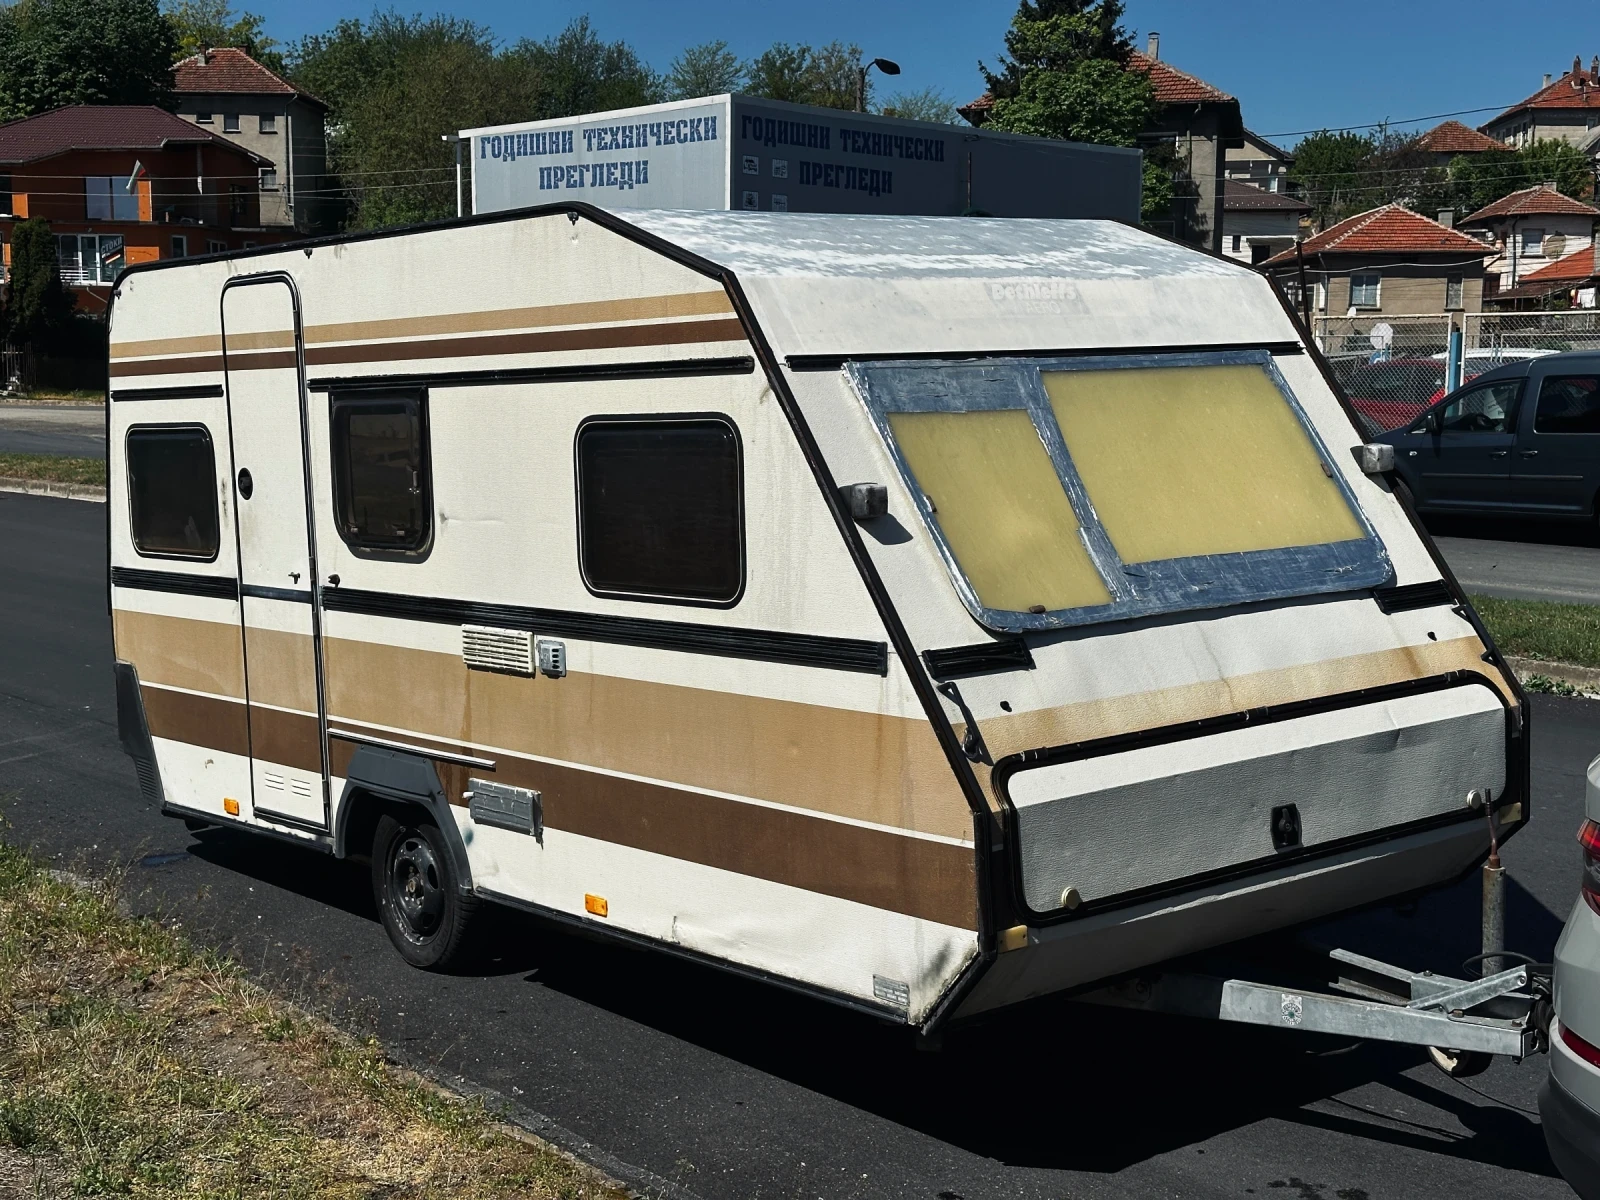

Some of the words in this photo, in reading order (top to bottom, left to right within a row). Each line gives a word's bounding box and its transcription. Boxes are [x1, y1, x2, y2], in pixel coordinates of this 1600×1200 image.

[480, 130, 574, 162] ГОДИШНИ
[583, 116, 718, 153] ТЕХНИЧЕСКИ
[741, 114, 831, 148] ГОДИШНИ
[839, 128, 945, 162] ТЕХНИЧЕСКИ
[539, 160, 649, 190] ПРЕГЛЕДИ
[799, 161, 893, 197] ПРЕГЛЕДИ
